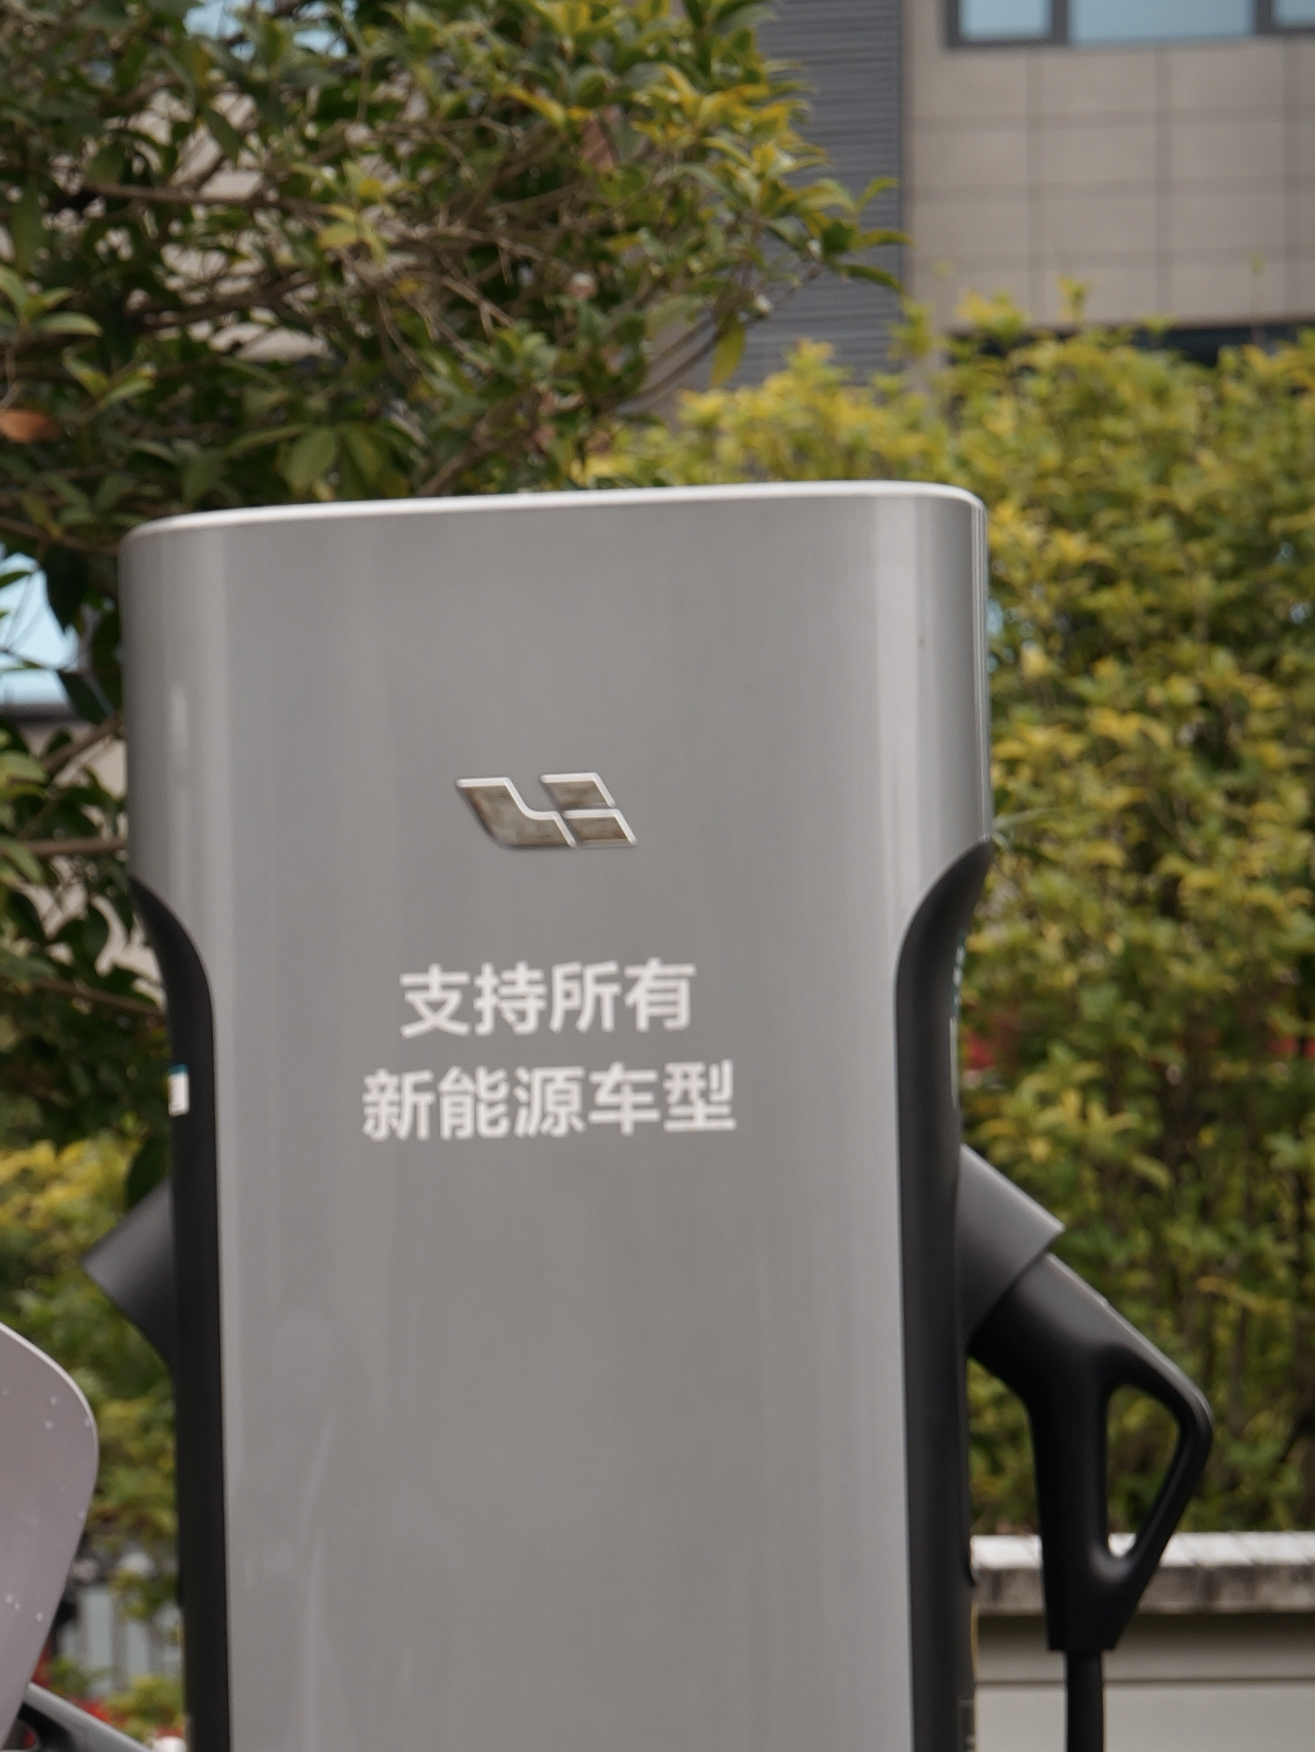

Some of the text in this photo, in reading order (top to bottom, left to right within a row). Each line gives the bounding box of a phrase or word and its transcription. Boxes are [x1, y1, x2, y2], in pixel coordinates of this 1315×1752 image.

[399, 957, 697, 1039] 支持所有
[362, 1060, 737, 1142] 新能源车型
